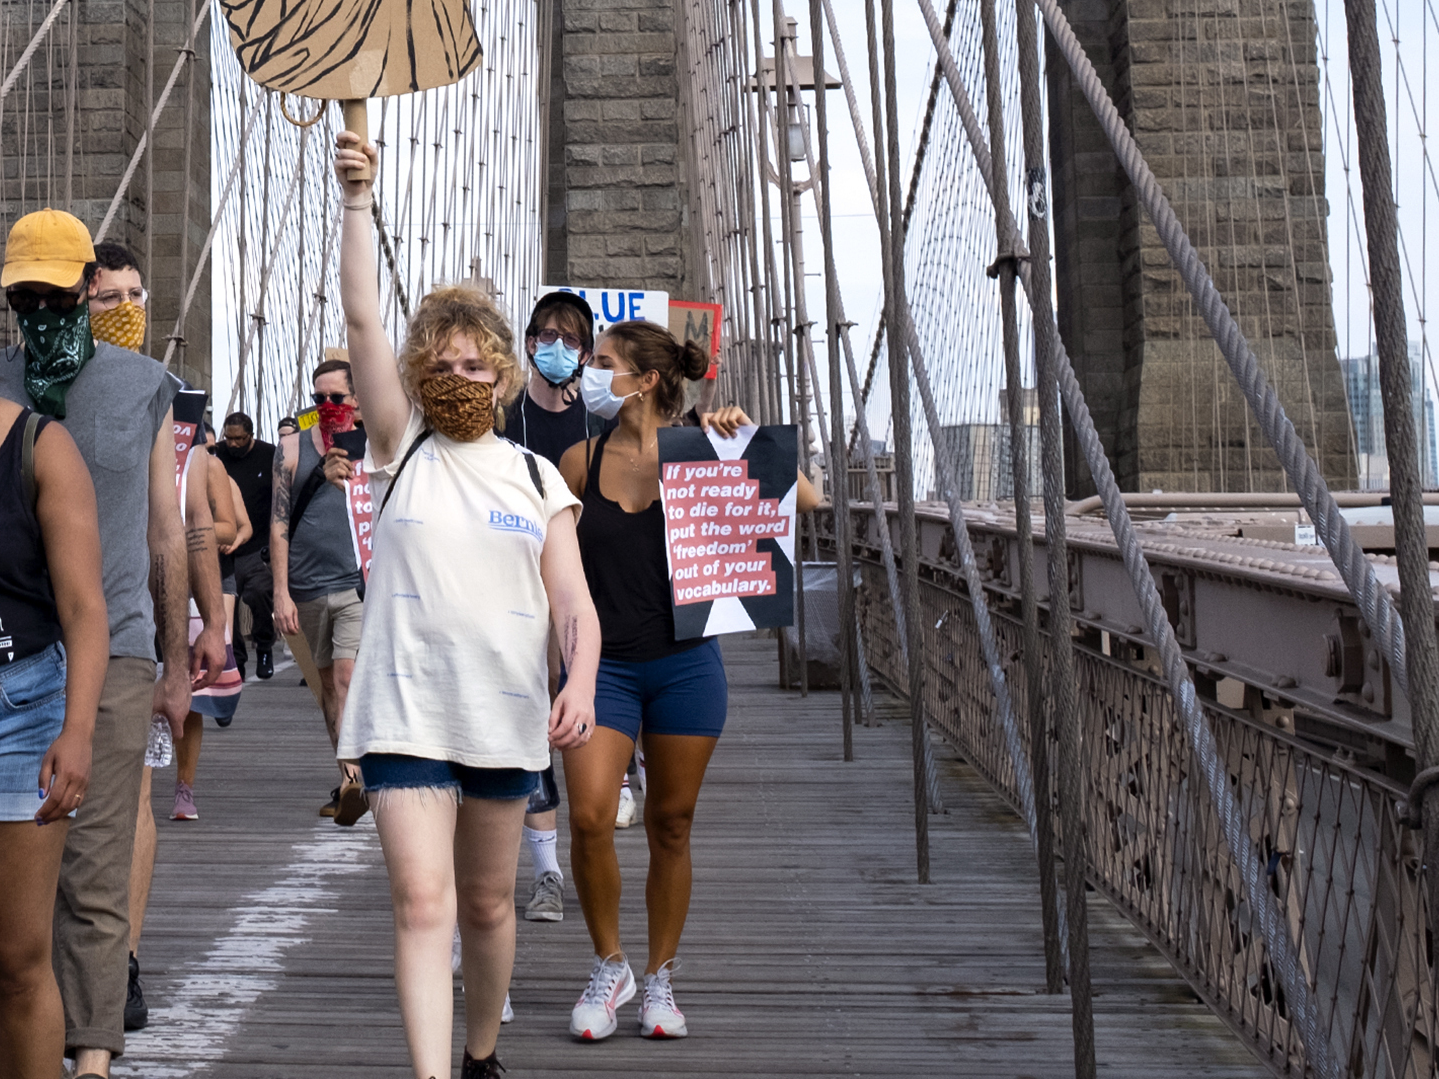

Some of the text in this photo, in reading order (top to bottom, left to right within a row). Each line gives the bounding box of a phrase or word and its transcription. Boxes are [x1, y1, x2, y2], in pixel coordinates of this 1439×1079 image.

[666, 463, 743, 482] If you're
[666, 482, 757, 500] not ready
[668, 502, 777, 520] to die for it,
[670, 519, 786, 543] put the word
[672, 539, 752, 560] 'freedom'
[675, 560, 766, 580] out of your
[676, 578, 771, 601] vocabulary.
